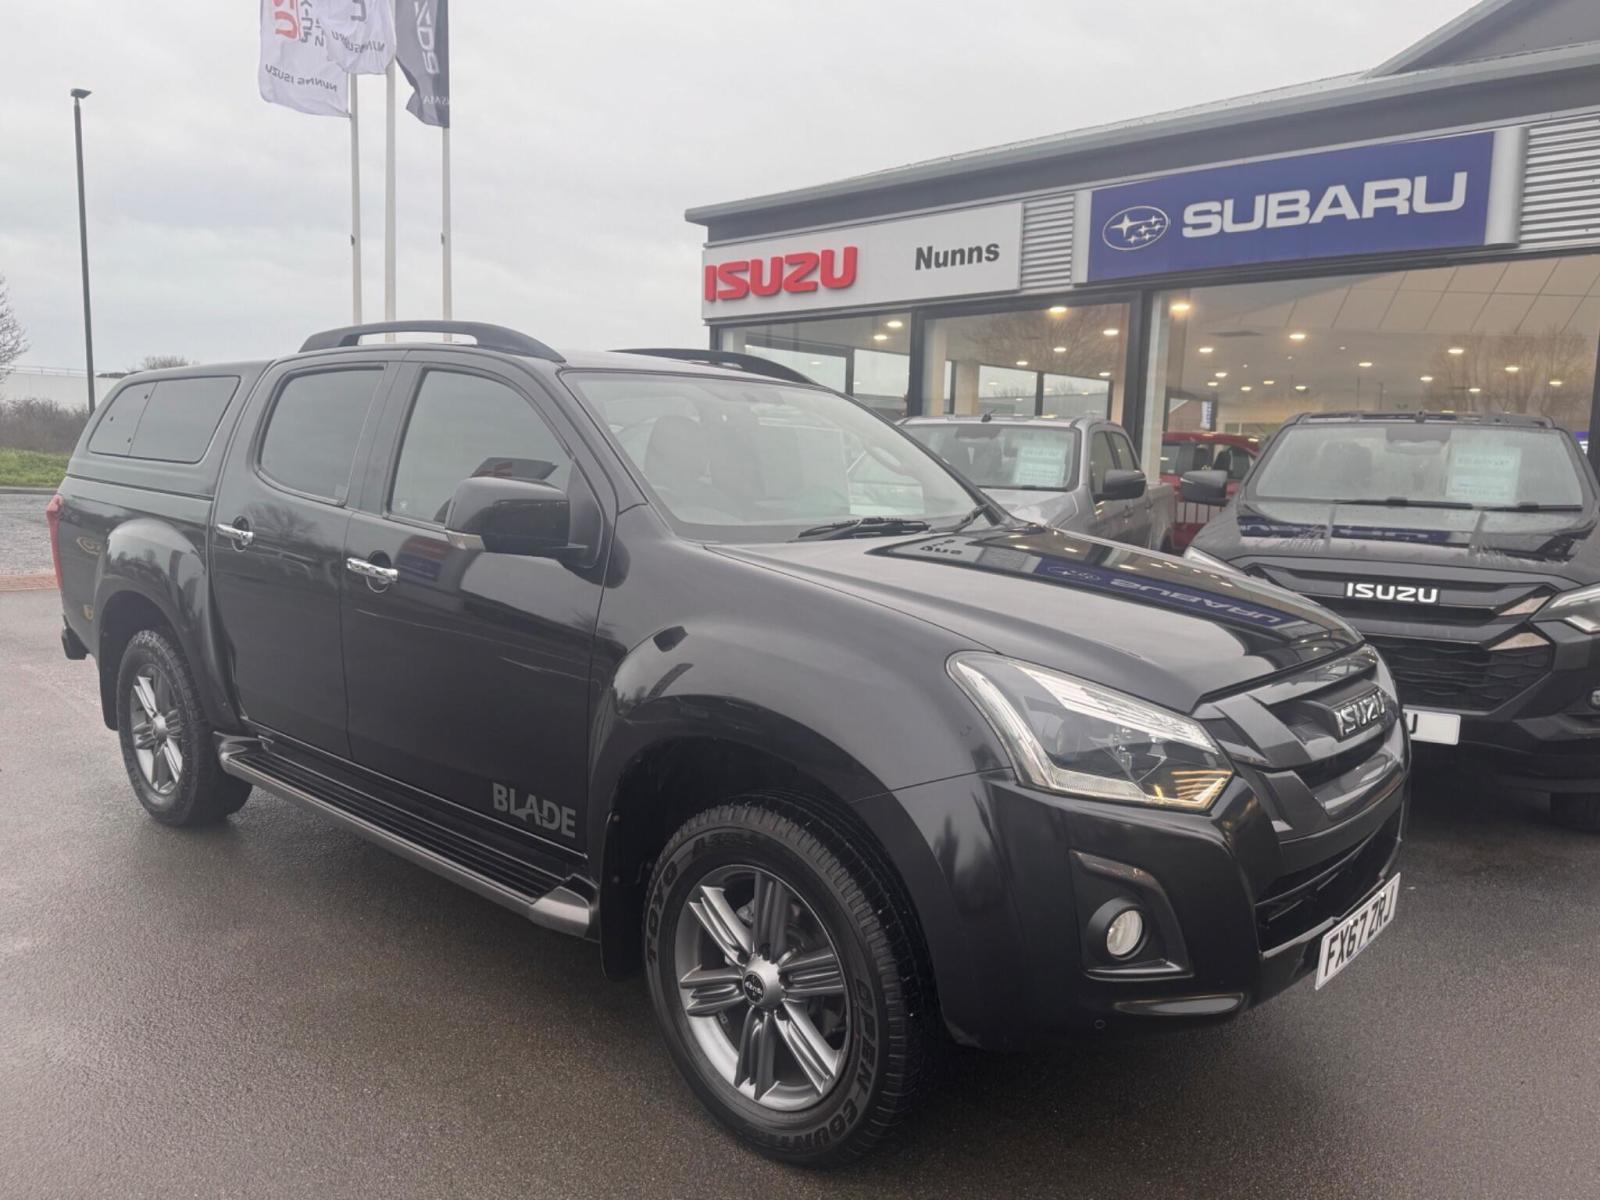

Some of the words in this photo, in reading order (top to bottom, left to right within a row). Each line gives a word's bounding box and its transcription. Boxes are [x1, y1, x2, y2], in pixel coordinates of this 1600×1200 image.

[1181, 171, 1468, 239] SUBARU
[704, 246, 859, 303] ISUZU
[915, 243, 1001, 271] Nunns
[1347, 582, 1439, 603] ISUZU
[1335, 690, 1388, 738] ISUZU
[493, 782, 576, 838] BLADE
[1324, 910, 1369, 977] FX67
[1367, 885, 1395, 940] ZRJ
